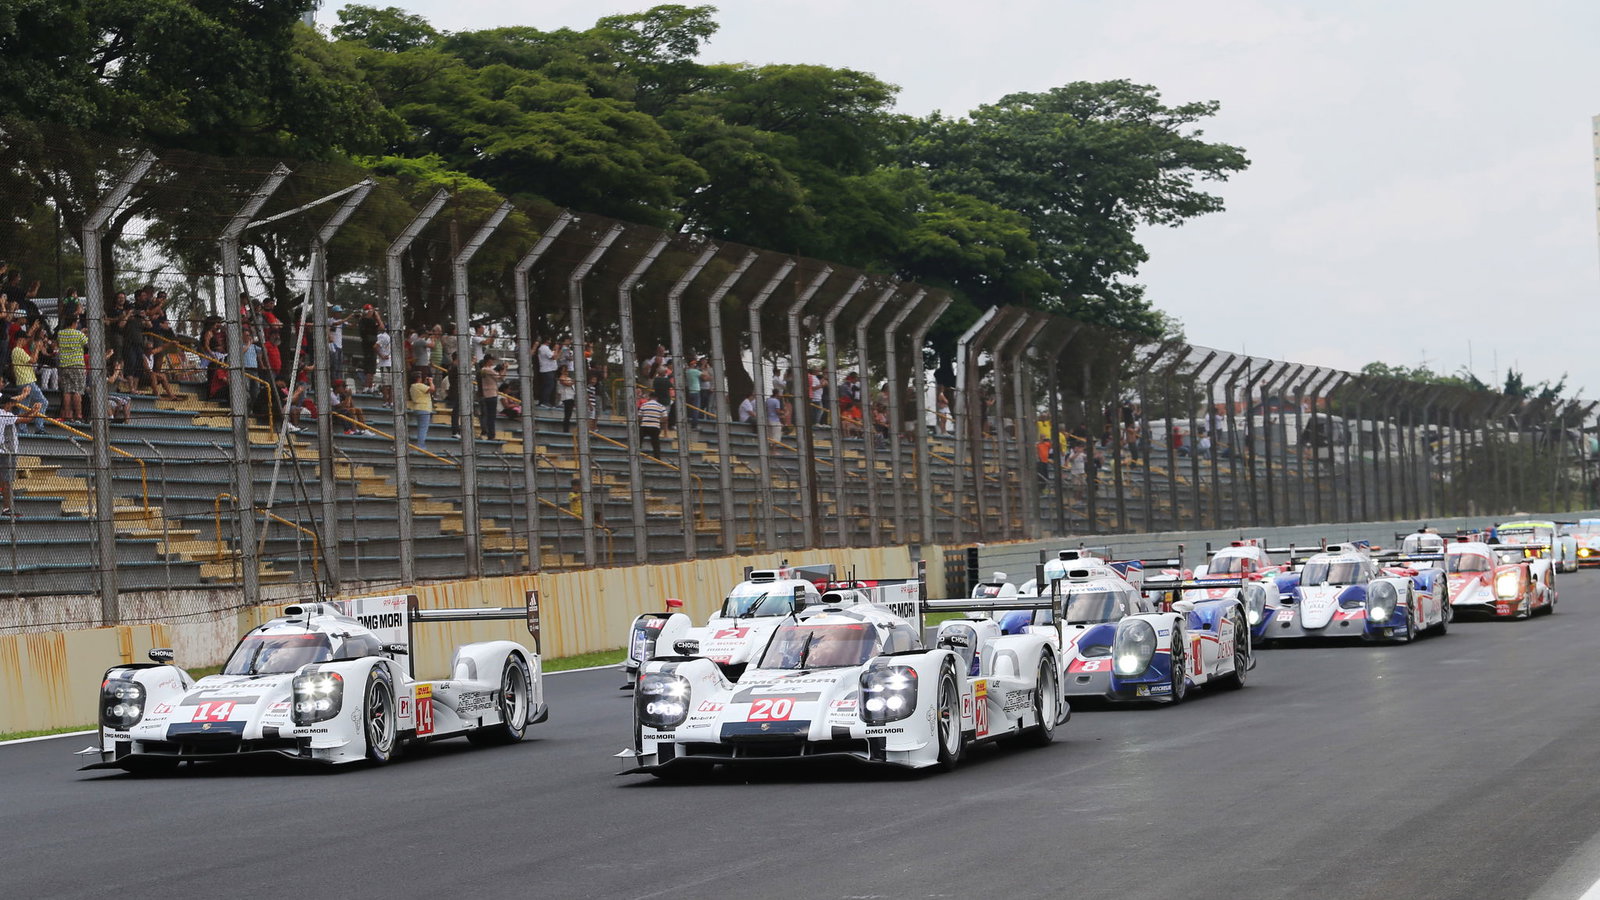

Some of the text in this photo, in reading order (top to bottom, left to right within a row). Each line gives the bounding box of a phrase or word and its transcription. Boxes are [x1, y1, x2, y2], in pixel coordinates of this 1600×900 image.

[885, 603, 915, 618] MG MORI
[379, 612, 402, 629] MORI
[724, 629, 741, 638] 2
[1081, 660, 1101, 671] 8
[193, 702, 232, 720] 14
[401, 700, 409, 714] P1
[750, 699, 793, 720] 20
[416, 701, 432, 731] 14
[977, 701, 987, 736] 20
